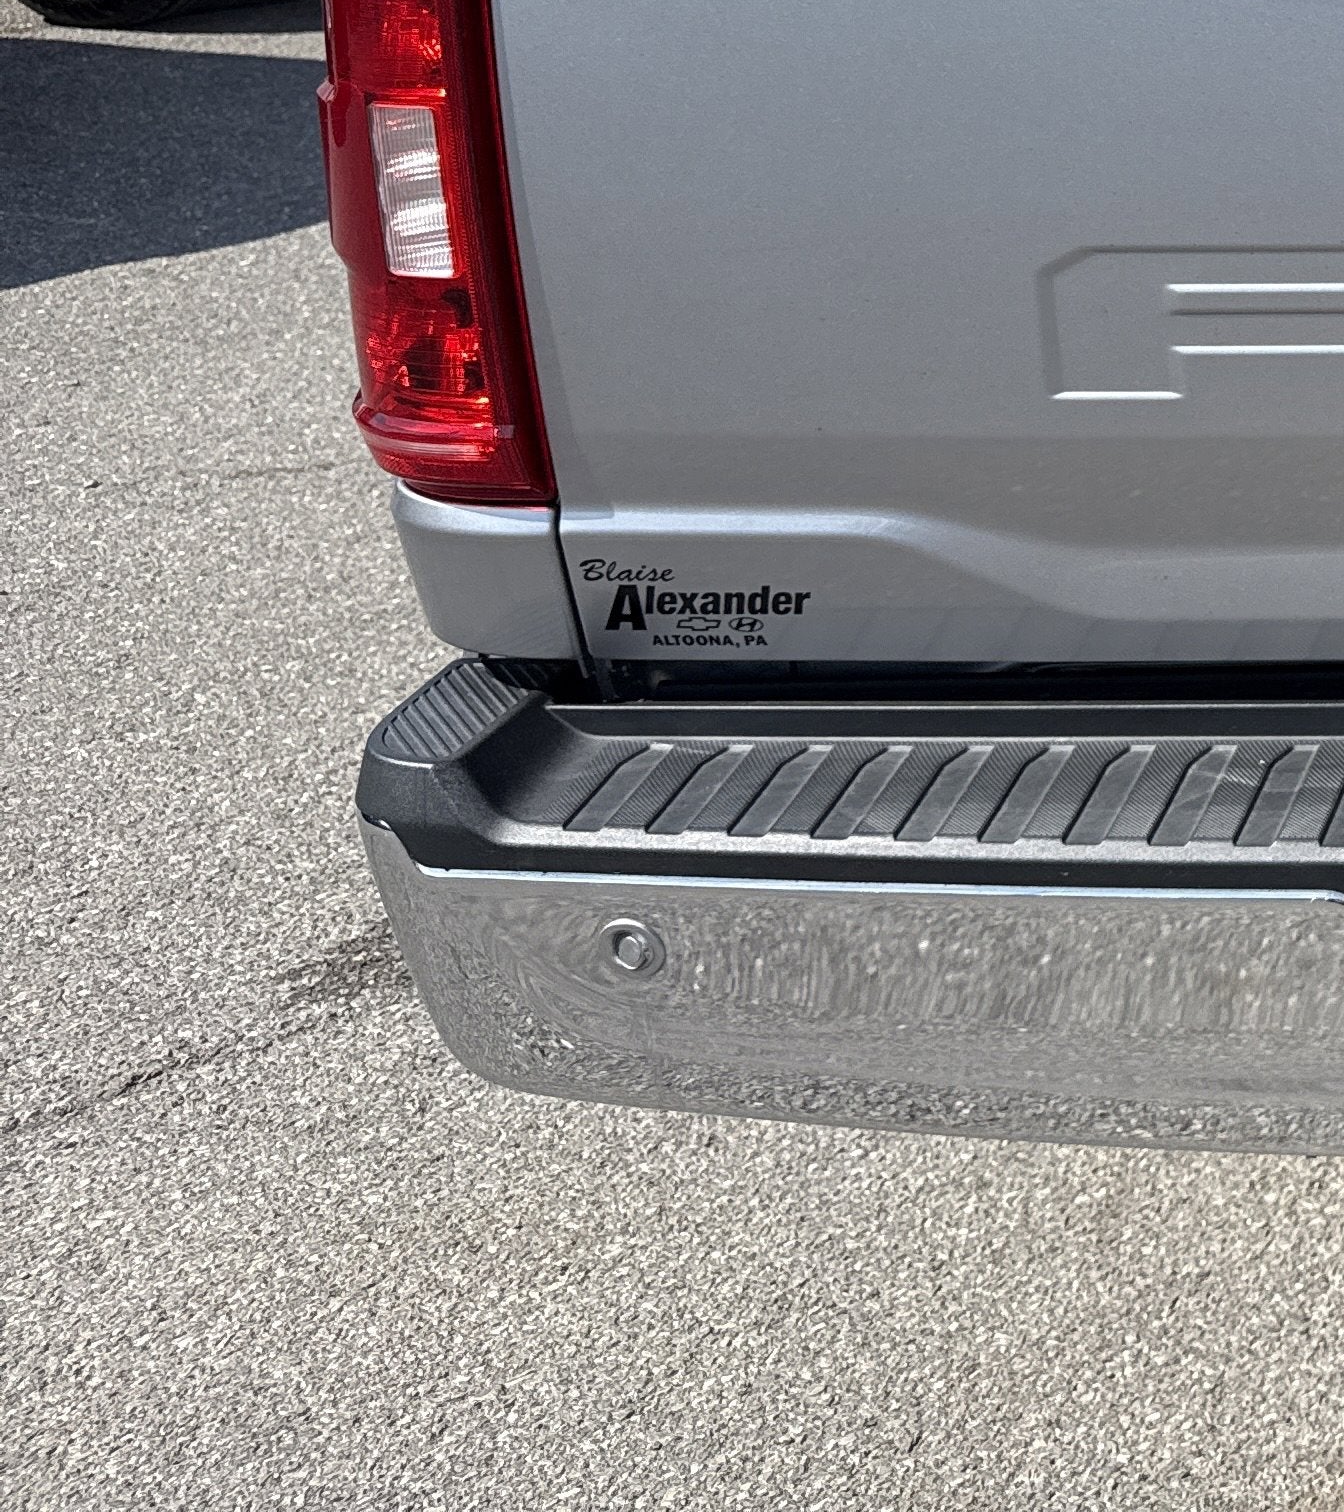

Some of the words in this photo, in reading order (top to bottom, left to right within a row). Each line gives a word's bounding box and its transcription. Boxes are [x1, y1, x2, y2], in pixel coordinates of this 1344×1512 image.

[579, 558, 675, 582] Blaise
[604, 584, 811, 630] Alexander
[652, 634, 740, 648] ALTOONA,
[743, 635, 768, 646] PA
